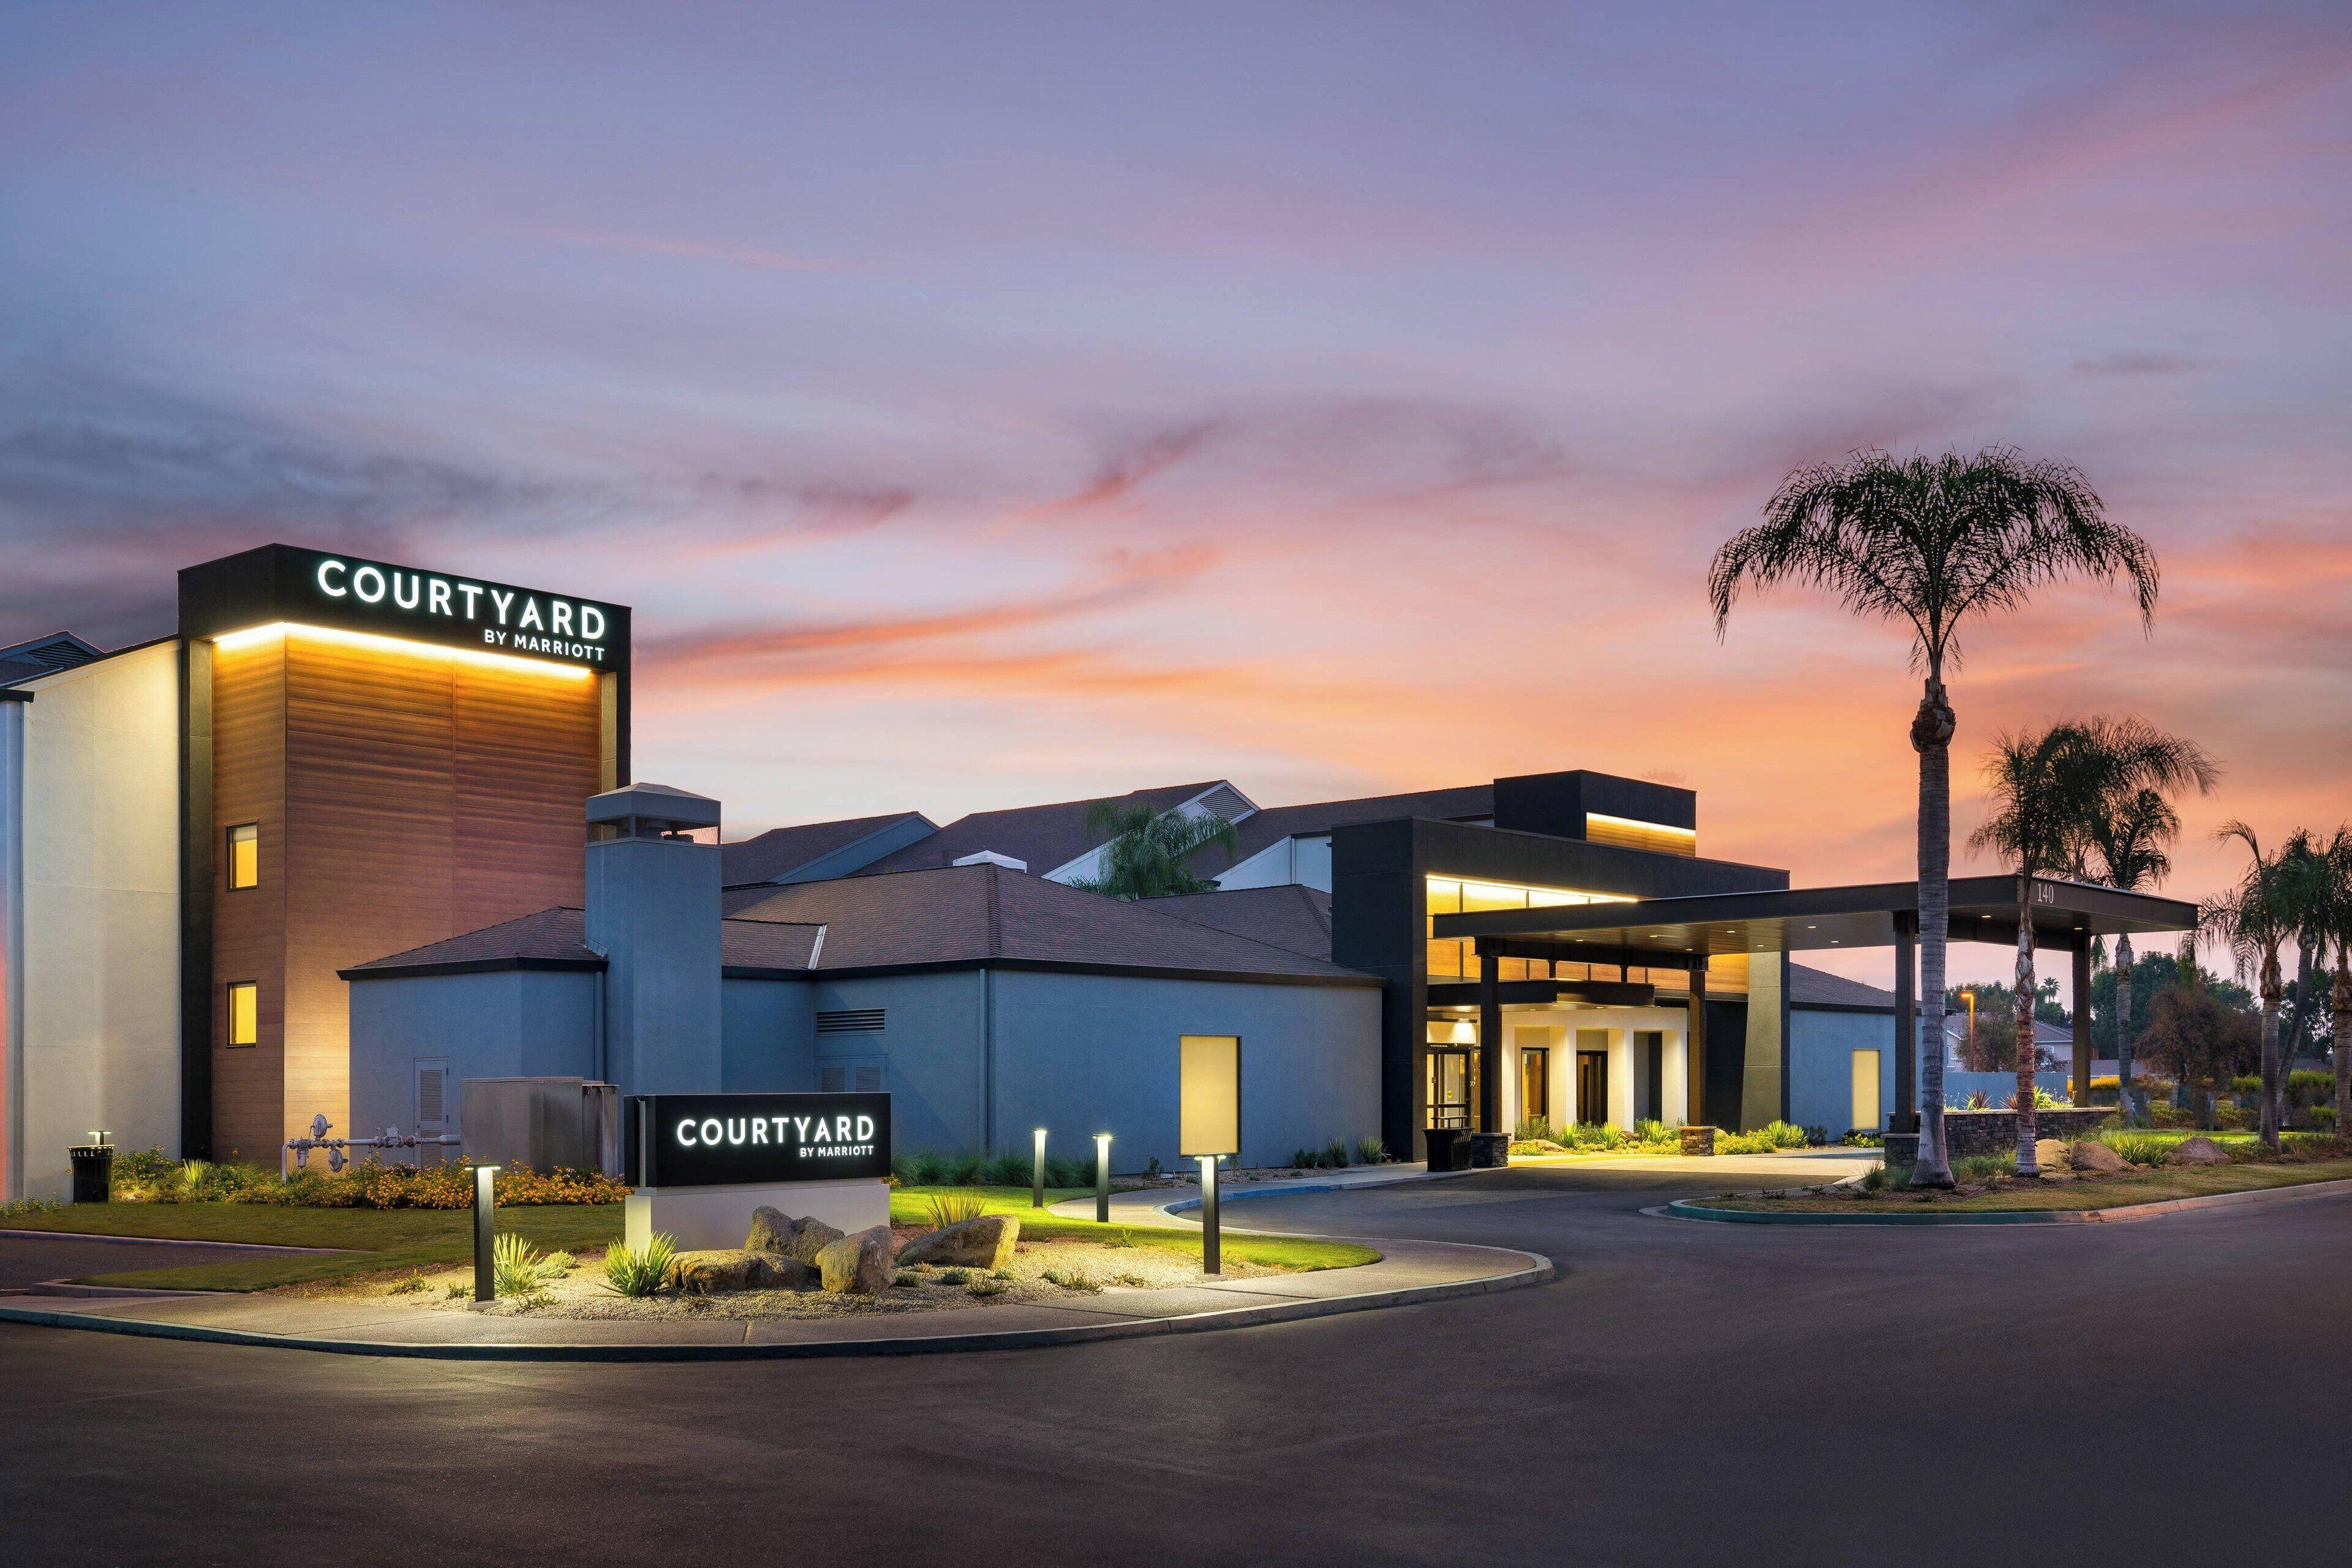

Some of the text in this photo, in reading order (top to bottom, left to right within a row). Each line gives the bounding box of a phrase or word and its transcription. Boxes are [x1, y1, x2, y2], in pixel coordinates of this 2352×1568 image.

[317, 560, 605, 639] COURTYARD
[484, 629, 605, 661] BY MARRIOTT
[2037, 883, 2054, 904] 140
[677, 1115, 875, 1146] COURTYARD
[800, 1145, 874, 1158] BY MARRIOTT
